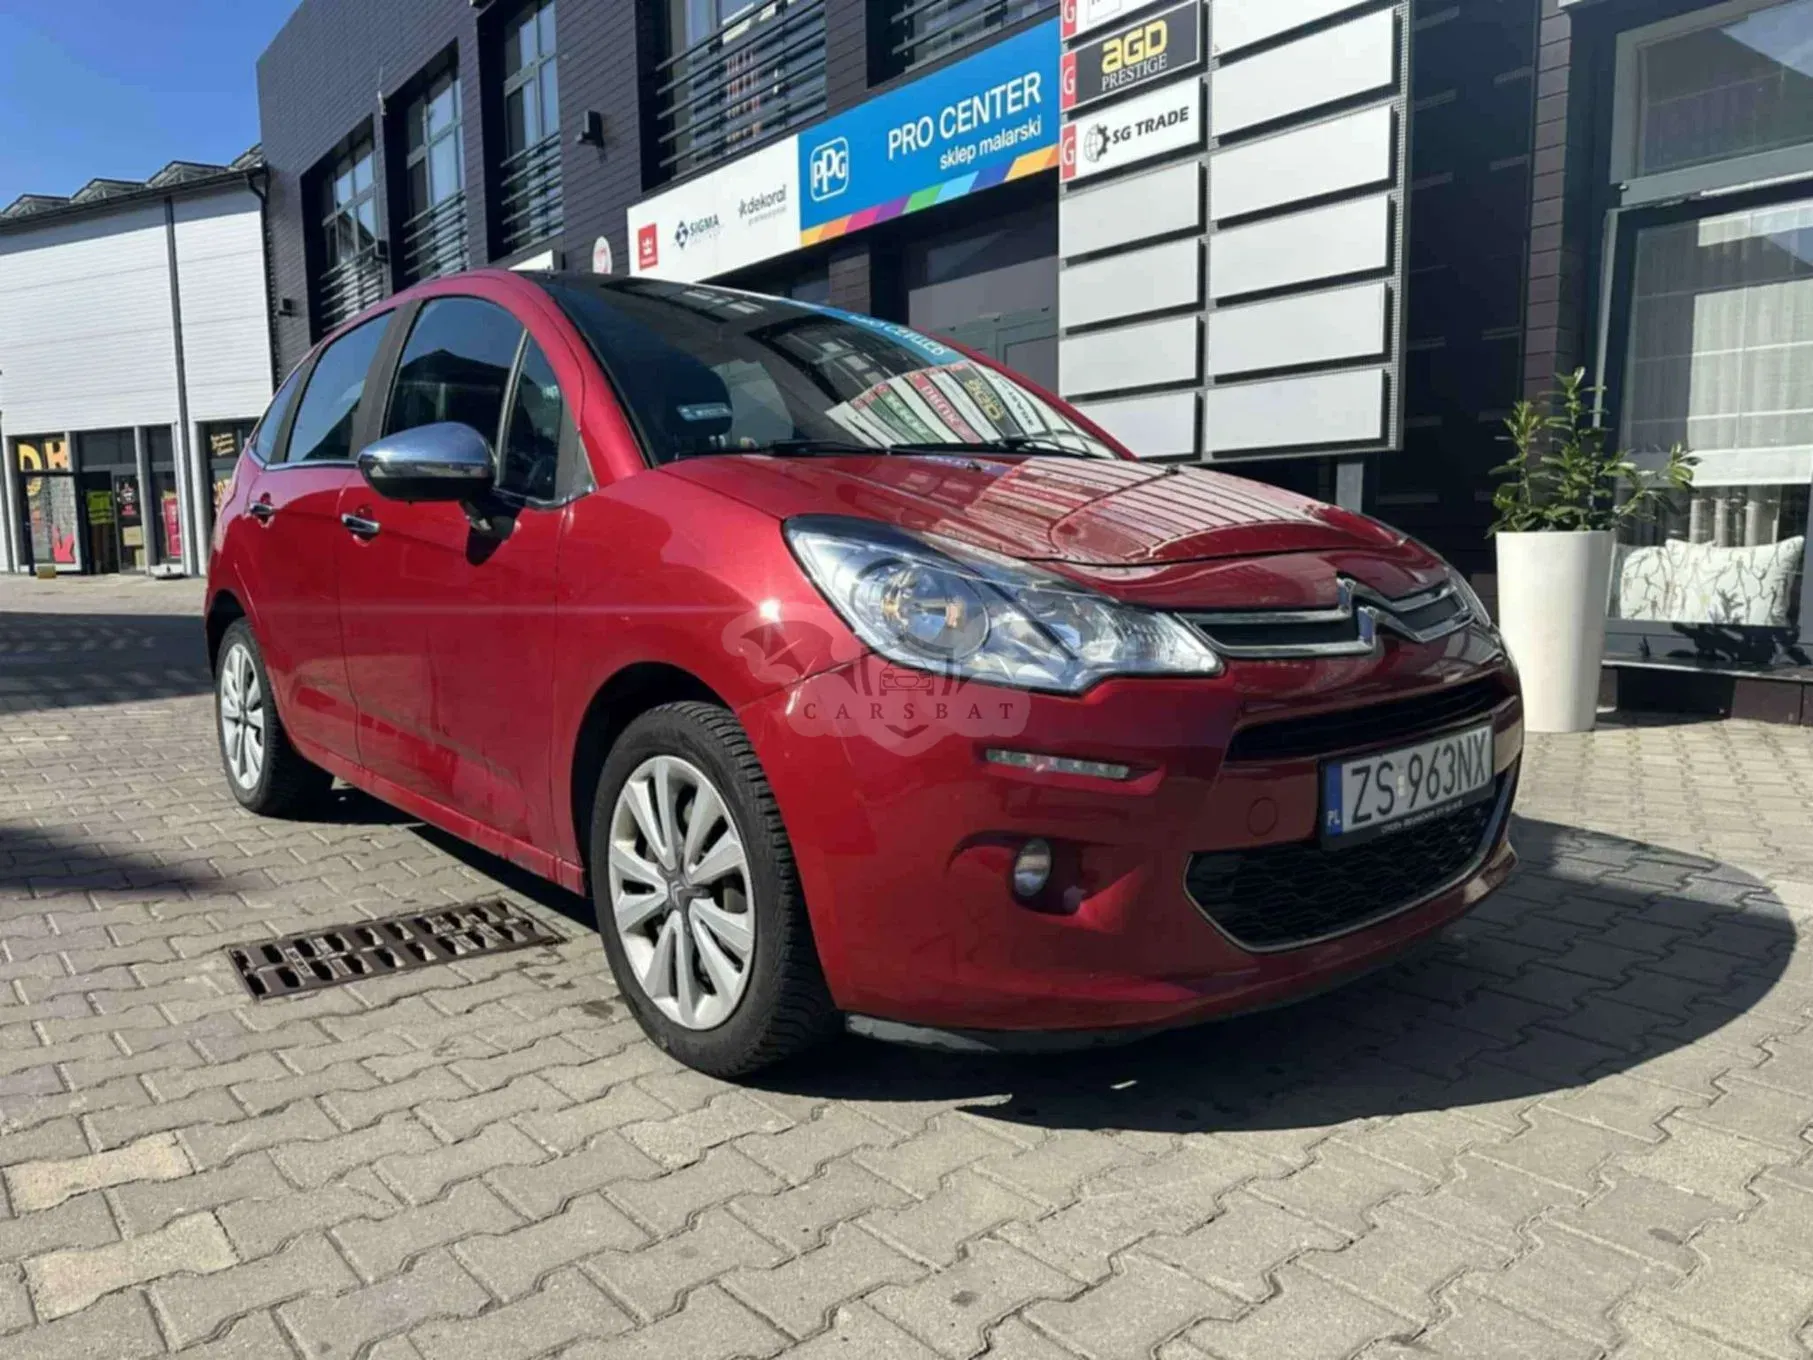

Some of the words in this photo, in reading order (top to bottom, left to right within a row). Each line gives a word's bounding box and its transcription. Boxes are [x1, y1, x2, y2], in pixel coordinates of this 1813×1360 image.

[1063, 66, 1075, 95] G
[1102, 53, 1168, 92] PRESTIGE
[888, 116, 934, 161] PRO
[939, 71, 1042, 139] CENTER
[1112, 126, 1132, 145] SG
[1135, 106, 1190, 137] TRADE
[939, 145, 977, 170] sklep
[978, 114, 1042, 157] malarski
[1063, 136, 1075, 166] G
[812, 148, 847, 193] PPG
[689, 214, 720, 236] SIGMA
[1351, 760, 1395, 825] ZS
[1407, 731, 1488, 810] 963NX
[1327, 810, 1341, 826] PL
